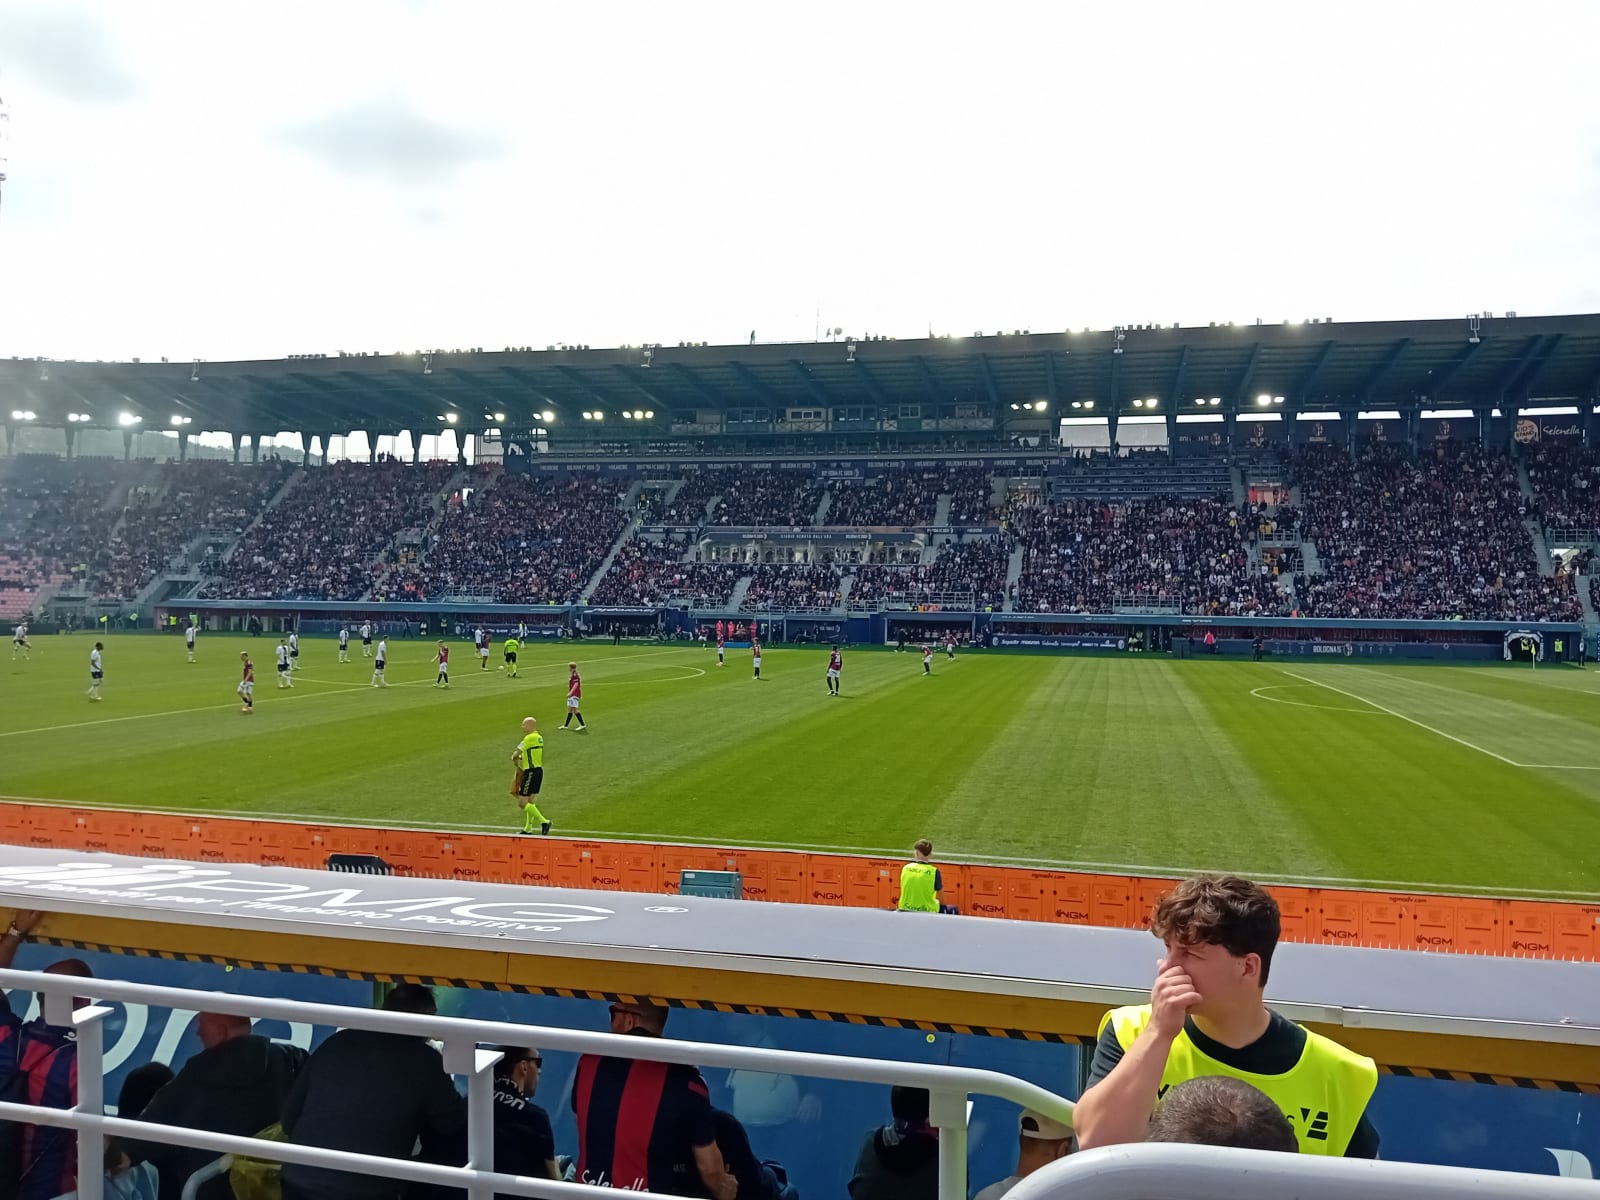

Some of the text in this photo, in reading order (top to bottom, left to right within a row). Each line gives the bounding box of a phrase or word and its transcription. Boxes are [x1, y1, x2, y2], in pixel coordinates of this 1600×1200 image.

[1543, 425, 1580, 435] Selenella
[458, 868, 480, 876] NGM
[526, 872, 549, 881] NGM
[597, 877, 619, 885] NGM
[818, 891, 843, 900] NGM
[978, 903, 1004, 913] NGM
[1061, 911, 1089, 920] NGM
[1327, 928, 1358, 939] NGM
[1422, 935, 1453, 945] NGM
[1518, 941, 1550, 951] NGM
